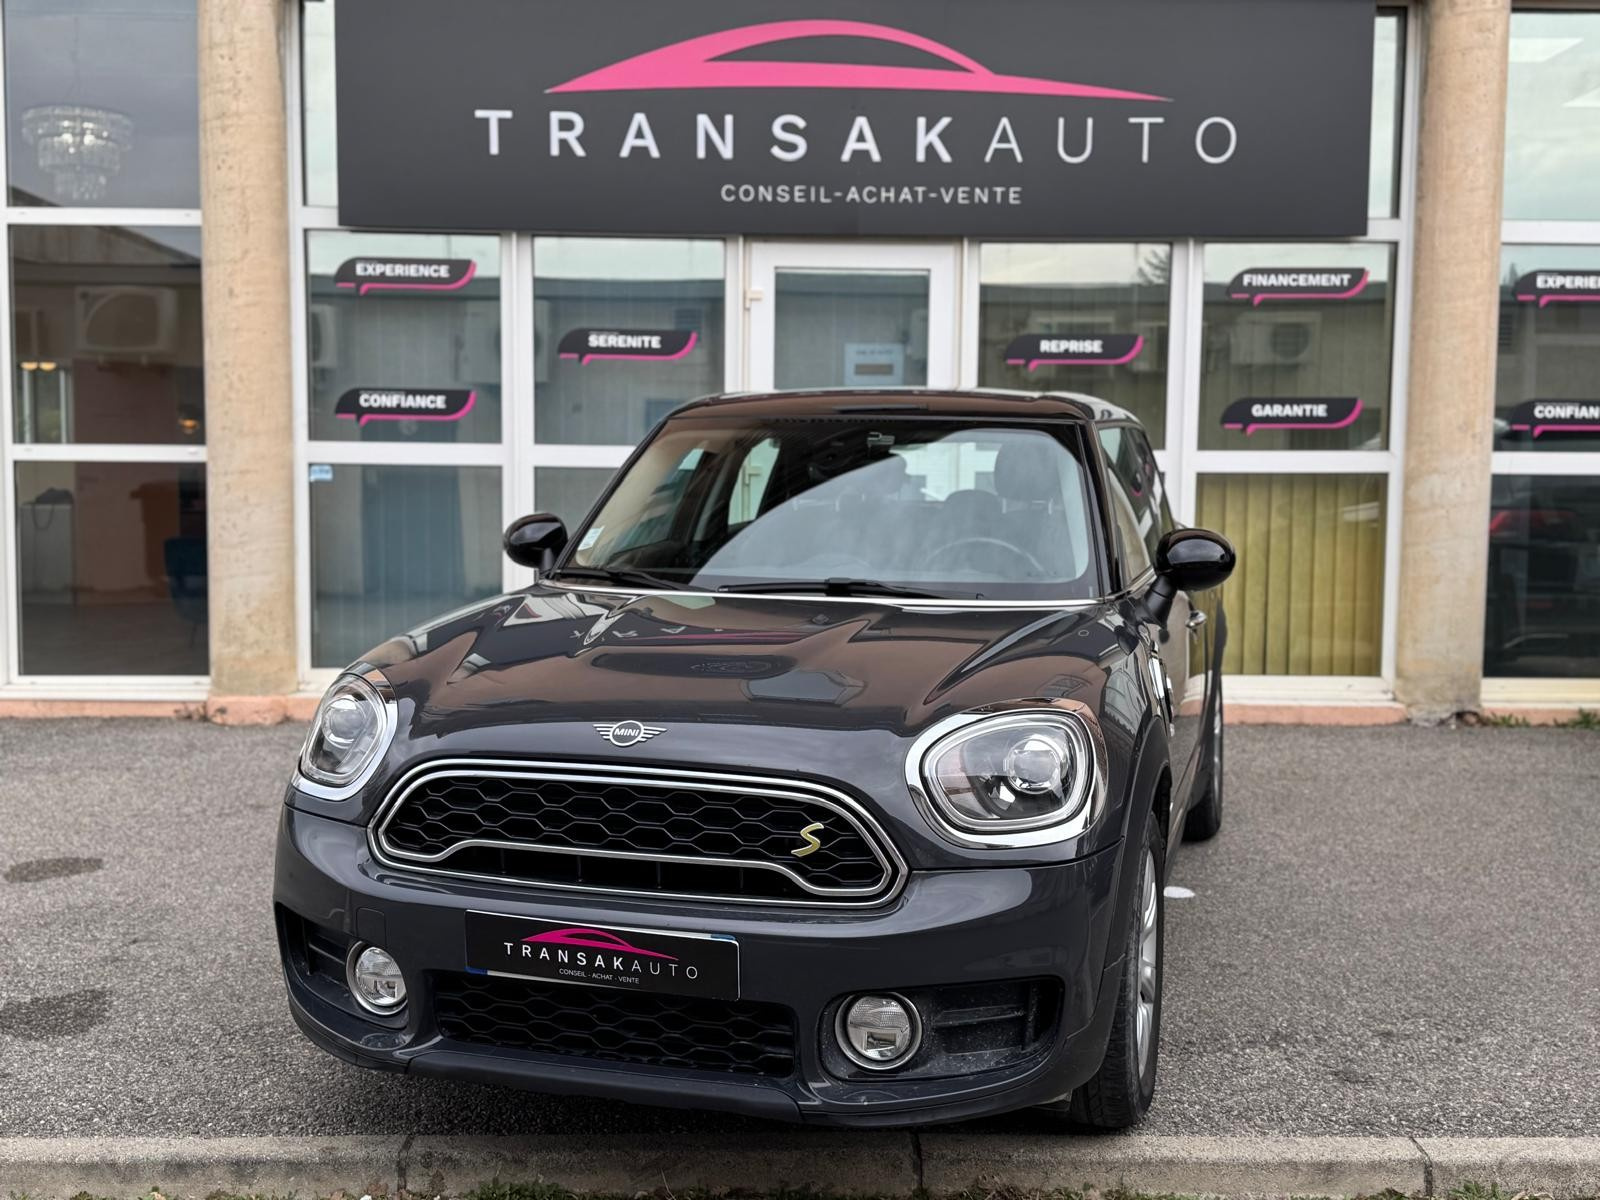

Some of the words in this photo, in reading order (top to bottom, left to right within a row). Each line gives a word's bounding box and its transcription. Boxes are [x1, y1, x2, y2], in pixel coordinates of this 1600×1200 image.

[475, 108, 1238, 164] TRANSAKAUTO
[355, 263, 450, 278] EXPERIENCE
[1242, 273, 1351, 287] FINANCEMENT
[1536, 275, 1600, 289] EXPERIE
[587, 334, 662, 349] SERENITE
[1039, 339, 1104, 353] REPRISE
[358, 393, 447, 409] CONFIANCE
[1251, 403, 1329, 417] GARANTIE
[613, 728, 640, 737] MINI
[791, 822, 825, 857] S
[503, 941, 699, 980] TRANSAKAUTO
[558, 968, 587, 978] CONSEIL
[592, 972, 613, 980] ACHAT
[618, 975, 640, 984] VENTE
